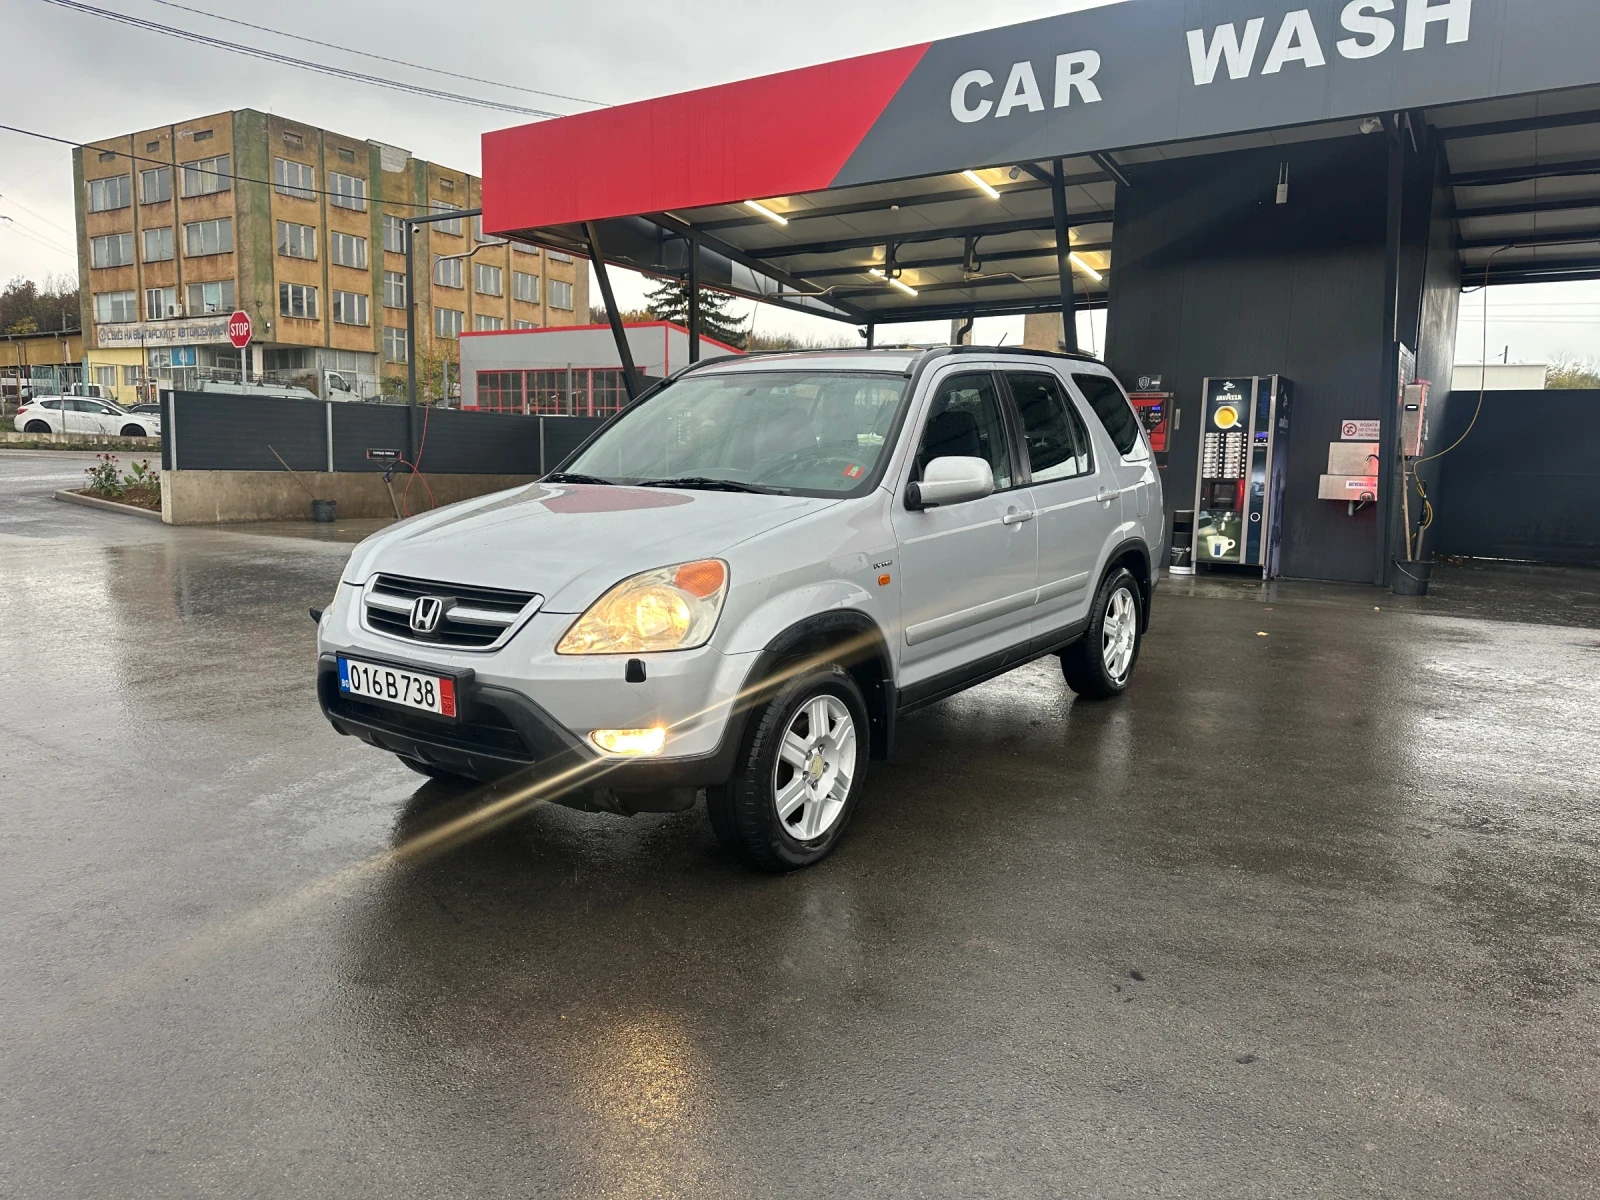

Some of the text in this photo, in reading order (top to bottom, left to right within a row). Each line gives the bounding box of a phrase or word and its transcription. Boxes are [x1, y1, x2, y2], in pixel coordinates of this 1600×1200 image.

[951, 0, 1471, 123] CAR WASH
[230, 322, 249, 336] STOP
[341, 665, 435, 707] BG 016B738
